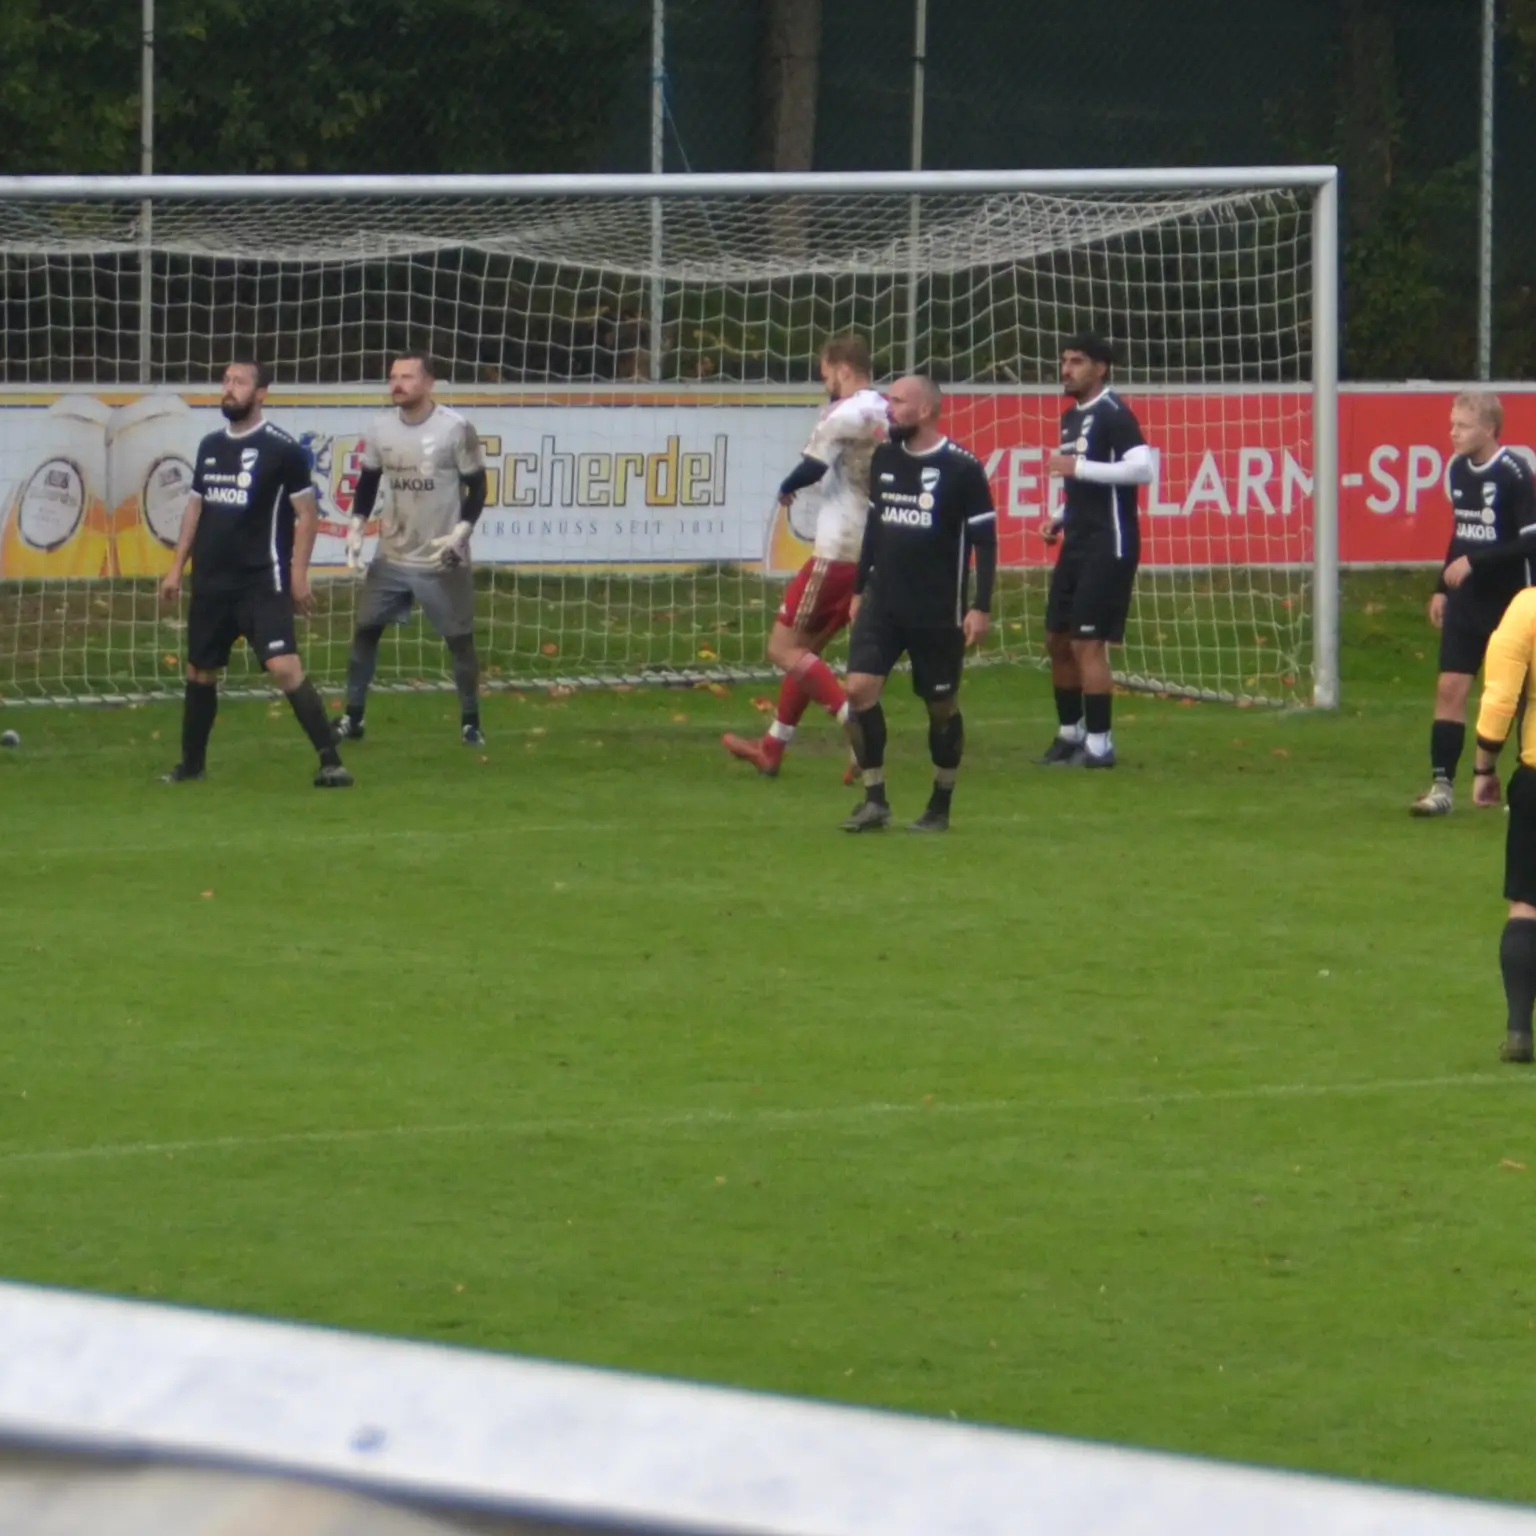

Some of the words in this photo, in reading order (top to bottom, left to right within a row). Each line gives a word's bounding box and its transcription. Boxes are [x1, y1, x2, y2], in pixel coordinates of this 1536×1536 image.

[203, 486, 249, 505] JAKOB
[881, 505, 933, 528] JAKOB
[481, 519, 599, 537] ERGENUSS
[614, 519, 663, 535] SEIT
[1455, 522, 1497, 541] JAKOB
